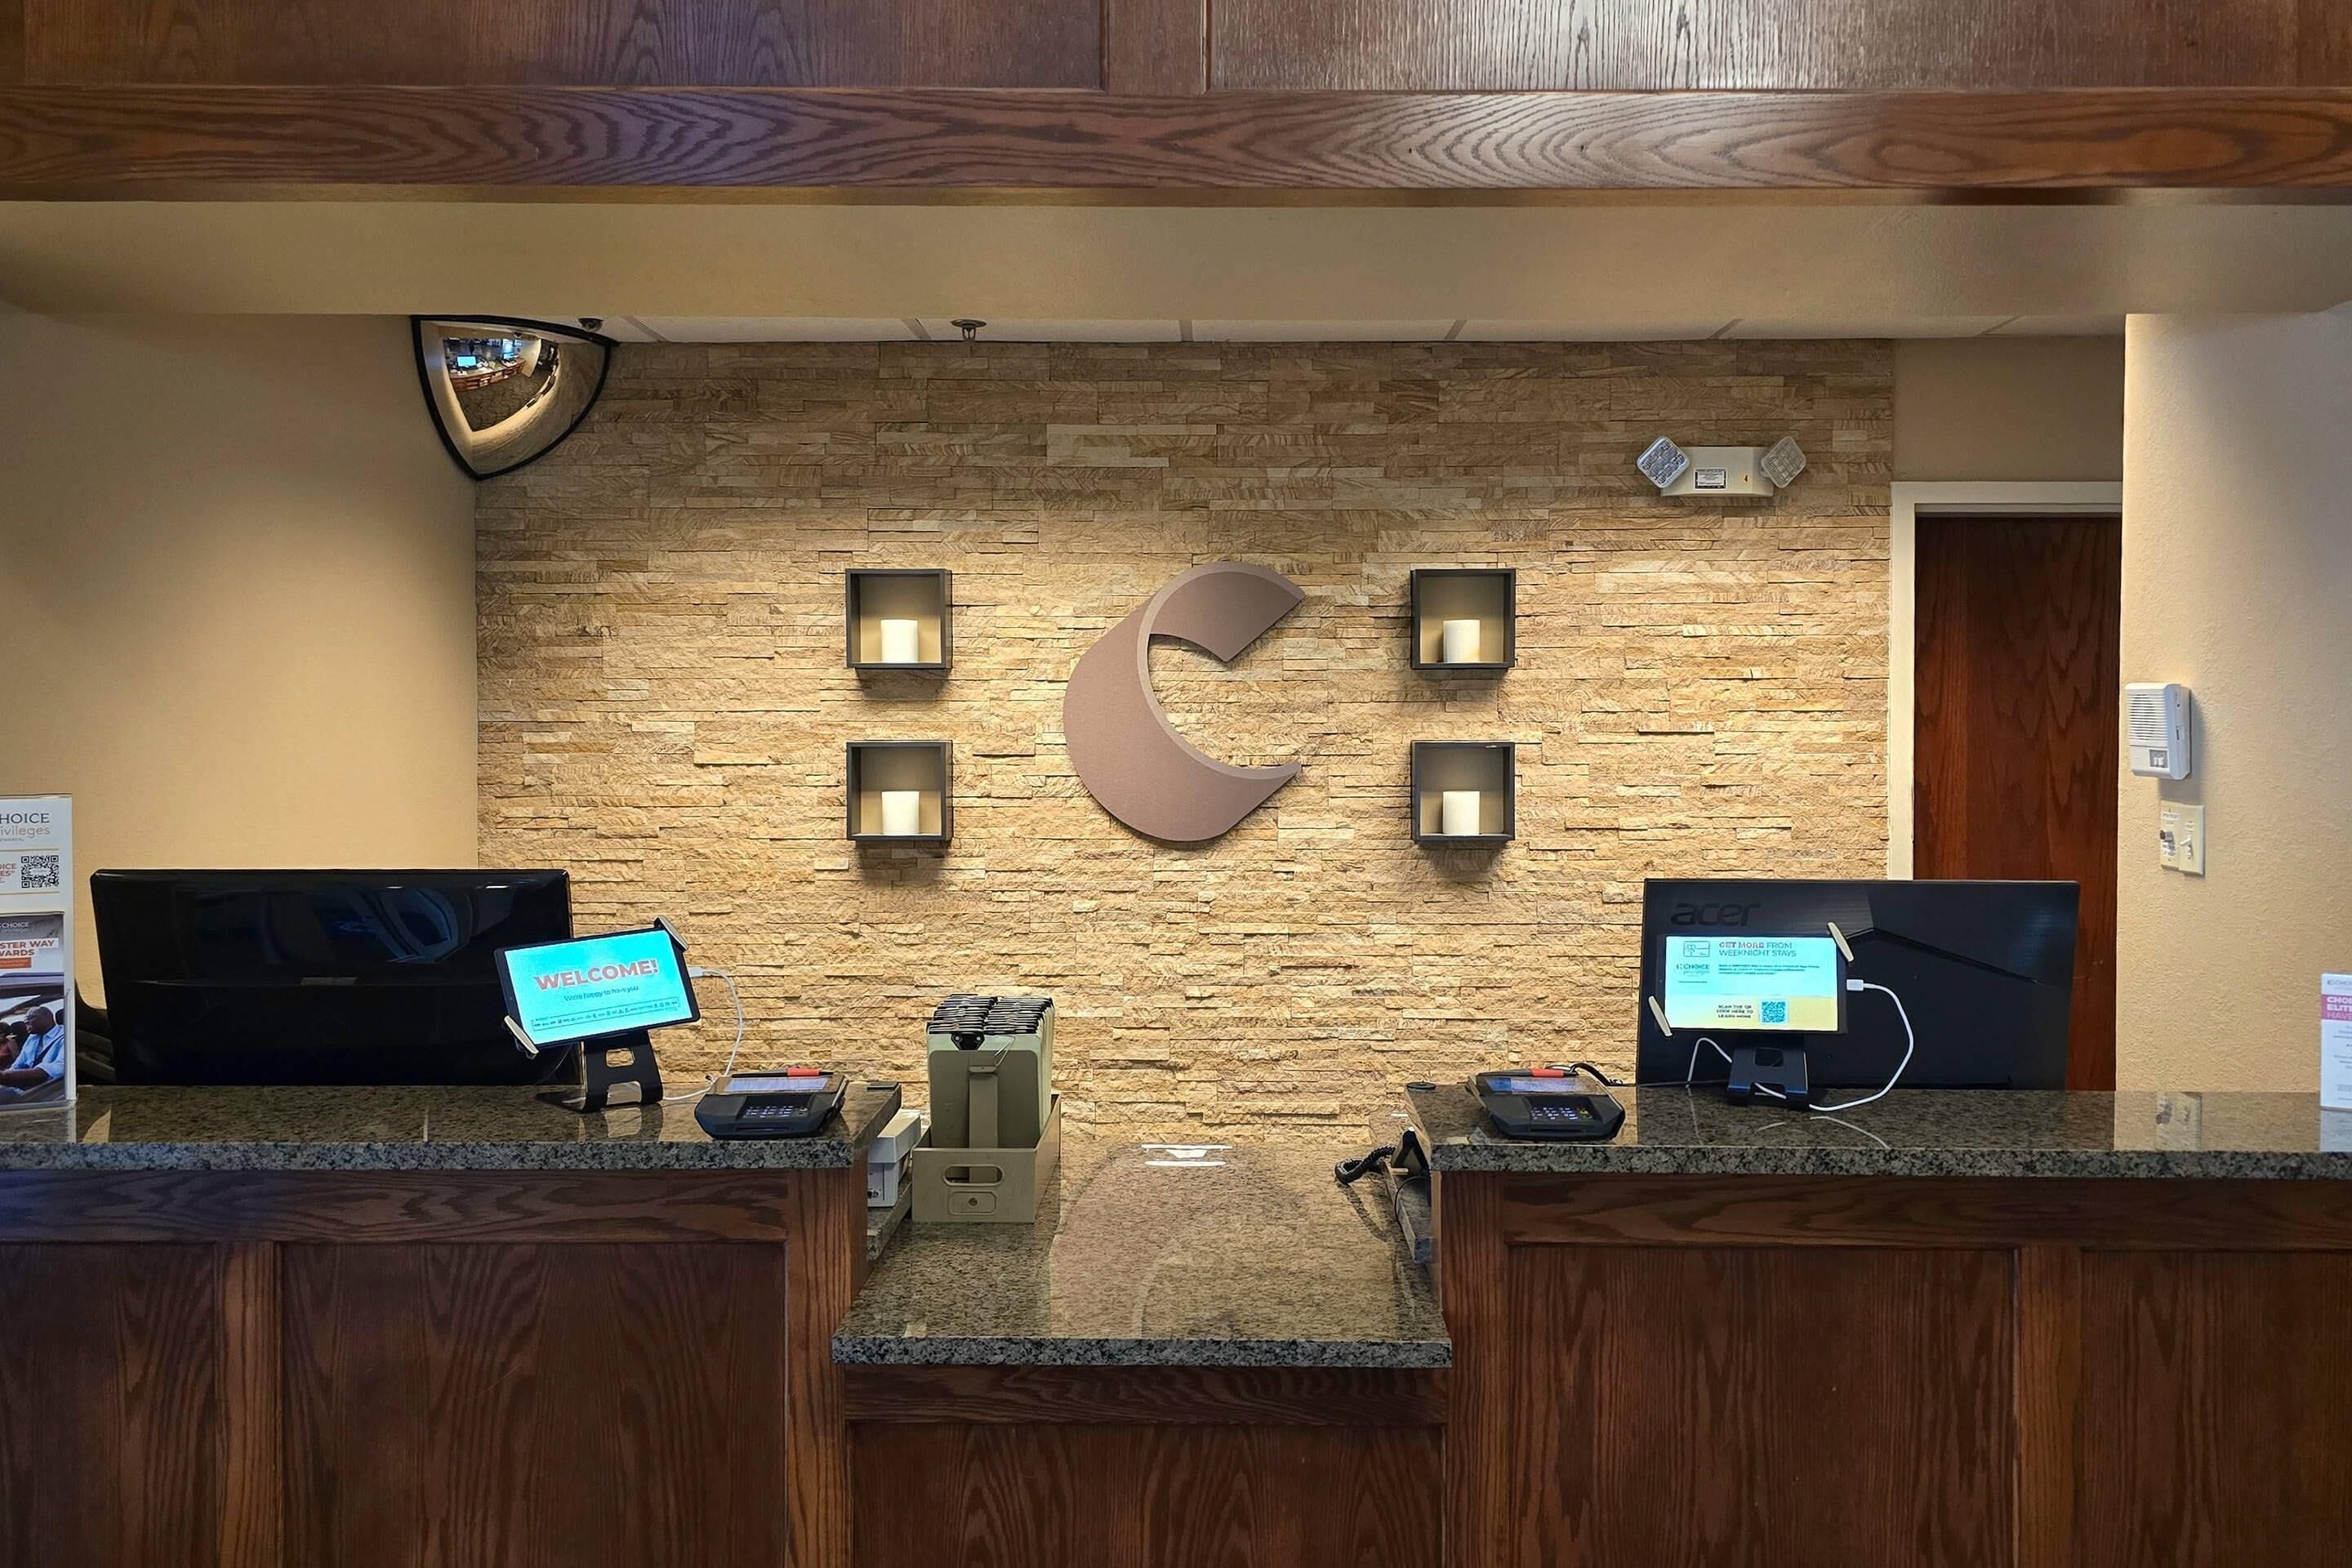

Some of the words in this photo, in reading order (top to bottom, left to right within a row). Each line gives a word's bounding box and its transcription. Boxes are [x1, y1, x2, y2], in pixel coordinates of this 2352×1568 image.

[1671, 902, 1762, 926] acer
[535, 960, 659, 991] WELCOME!
[583, 991, 603, 999] happy
